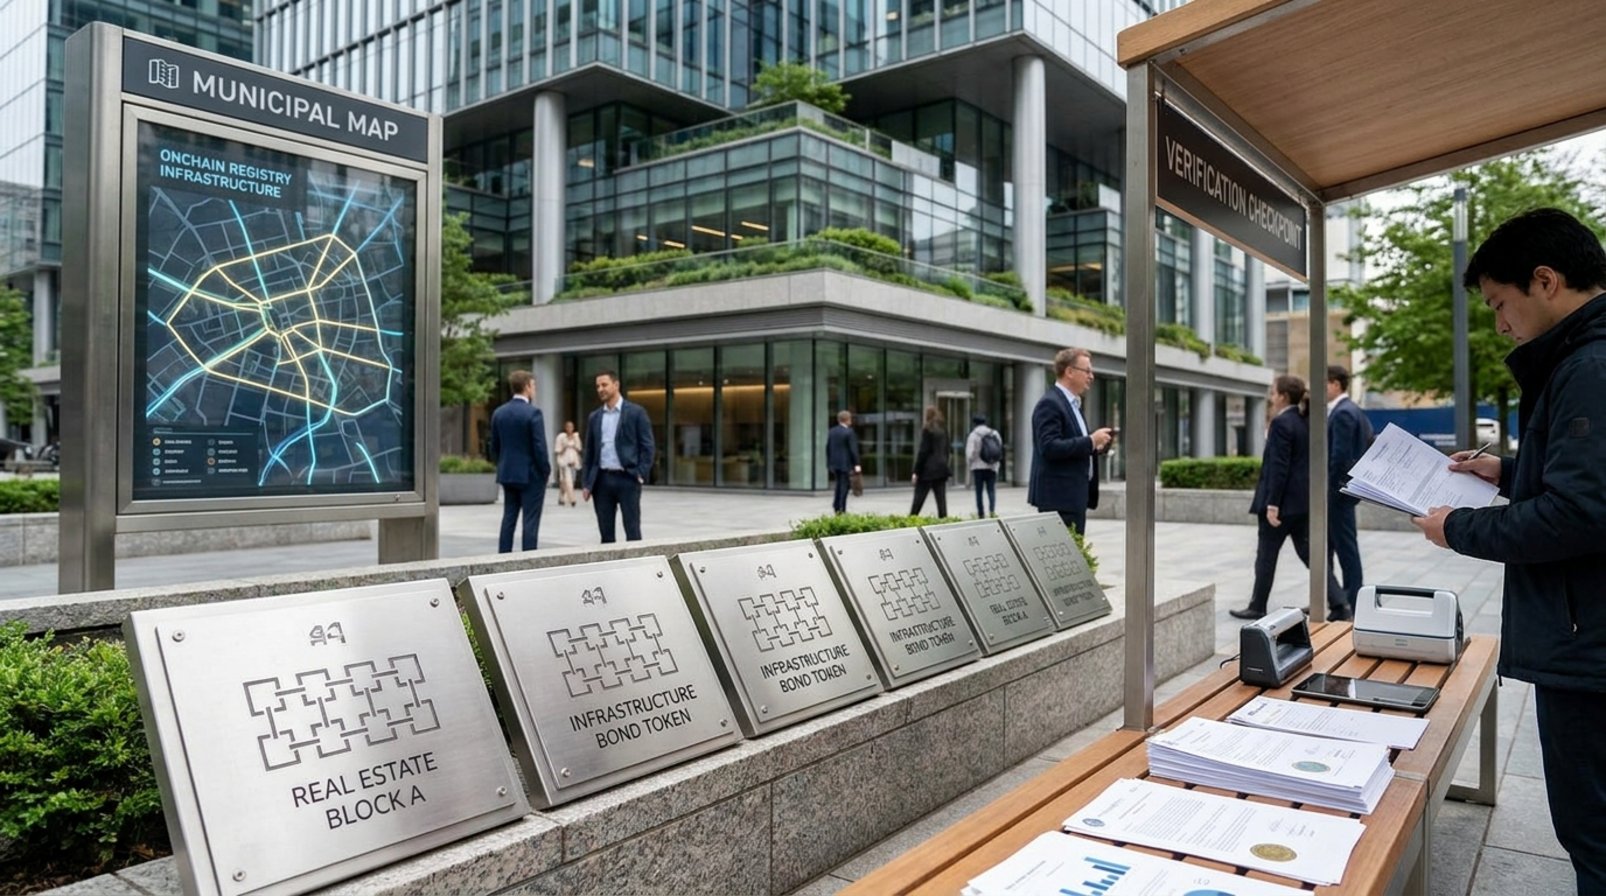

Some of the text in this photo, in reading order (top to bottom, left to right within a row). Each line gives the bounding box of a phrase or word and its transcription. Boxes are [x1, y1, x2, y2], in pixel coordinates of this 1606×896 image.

[192, 70, 399, 141] MUNICIPAL MAP
[160, 149, 292, 186] ONCHAIN REGISTRY
[160, 164, 281, 198] INFRASTRUCTURE
[1165, 135, 1302, 251] VERIFICATION CHECKPOINT
[779, 663, 847, 693] BOND TOKEN
[569, 684, 697, 732] INFRASTRUCTURE
[595, 708, 692, 749] BOND TOKEN
[291, 751, 438, 808] REAL ESTATE
[325, 784, 426, 830] BLOCK A
